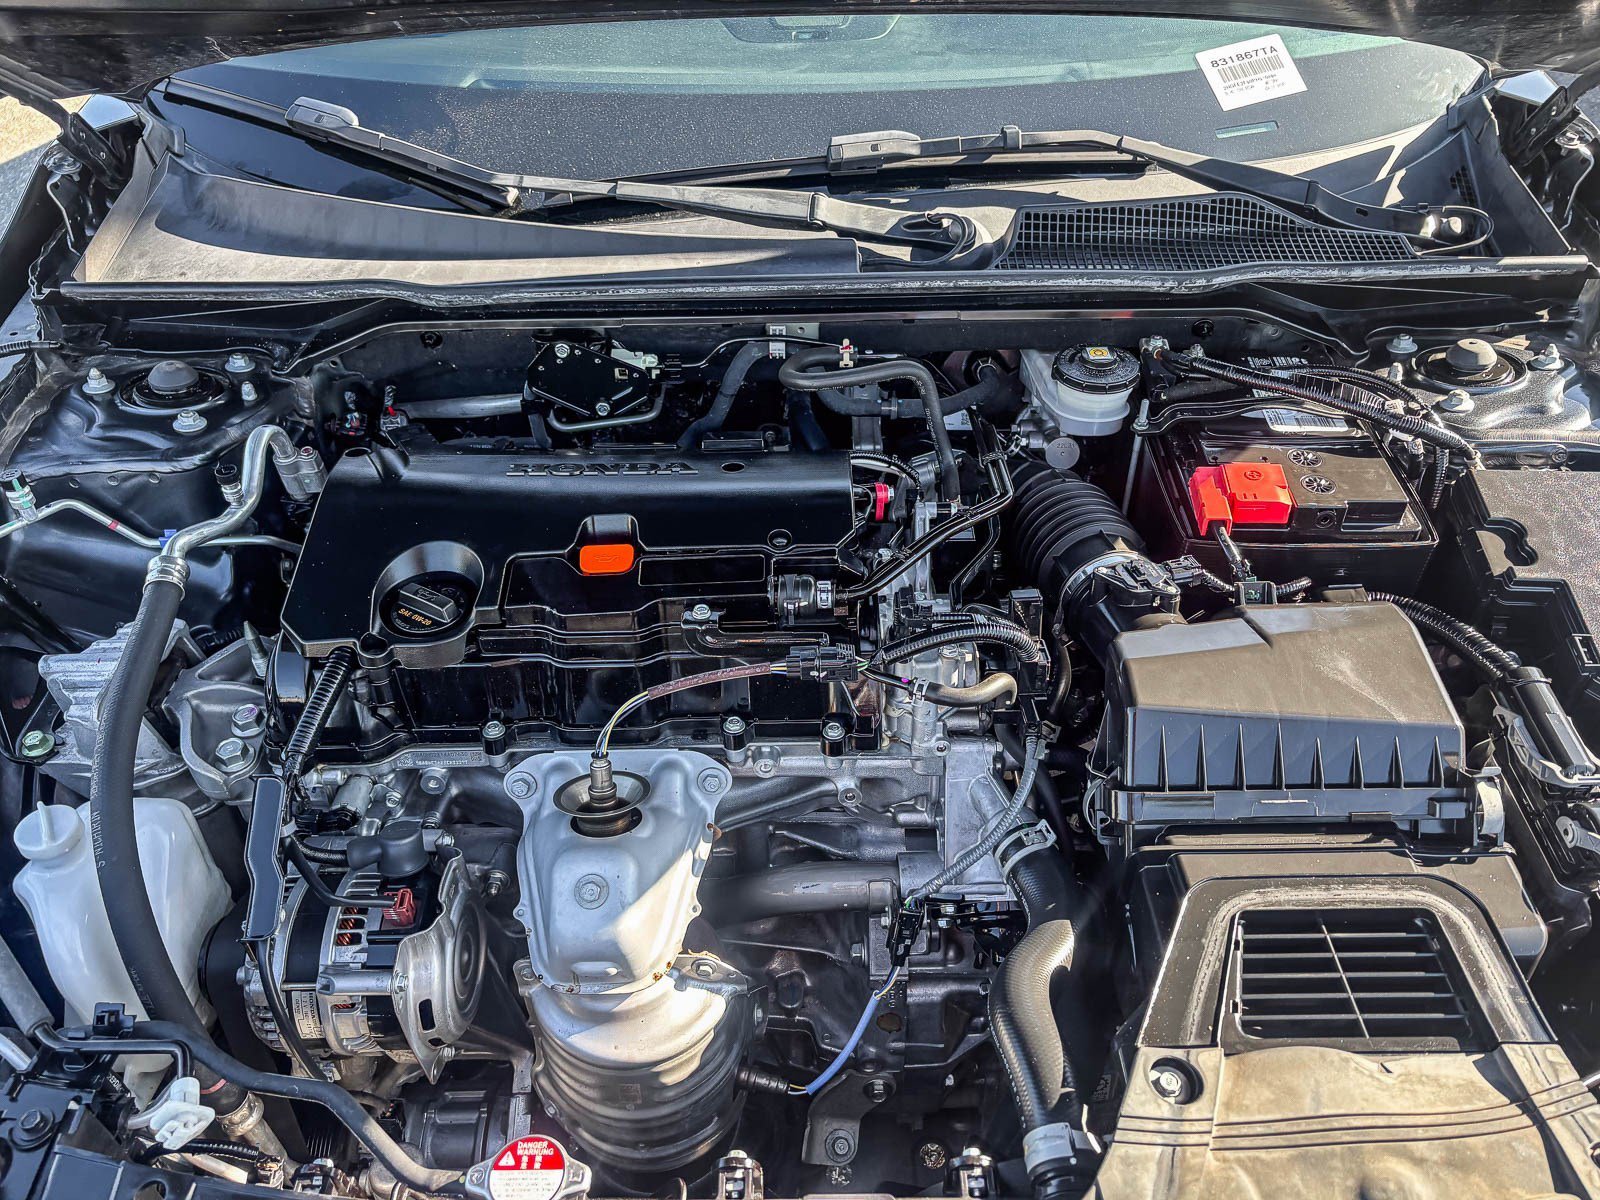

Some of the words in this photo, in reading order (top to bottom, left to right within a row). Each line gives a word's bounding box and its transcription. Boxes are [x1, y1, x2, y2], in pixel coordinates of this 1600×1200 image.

[1210, 45, 1278, 68] 831867TA
[506, 462, 699, 476] HONDA
[398, 608, 412, 618] SAE
[411, 613, 432, 626] 0W-20
[309, 992, 317, 1019] HONDA
[517, 1148, 554, 1156] WARNUNG
[518, 1141, 548, 1149] DANGER
